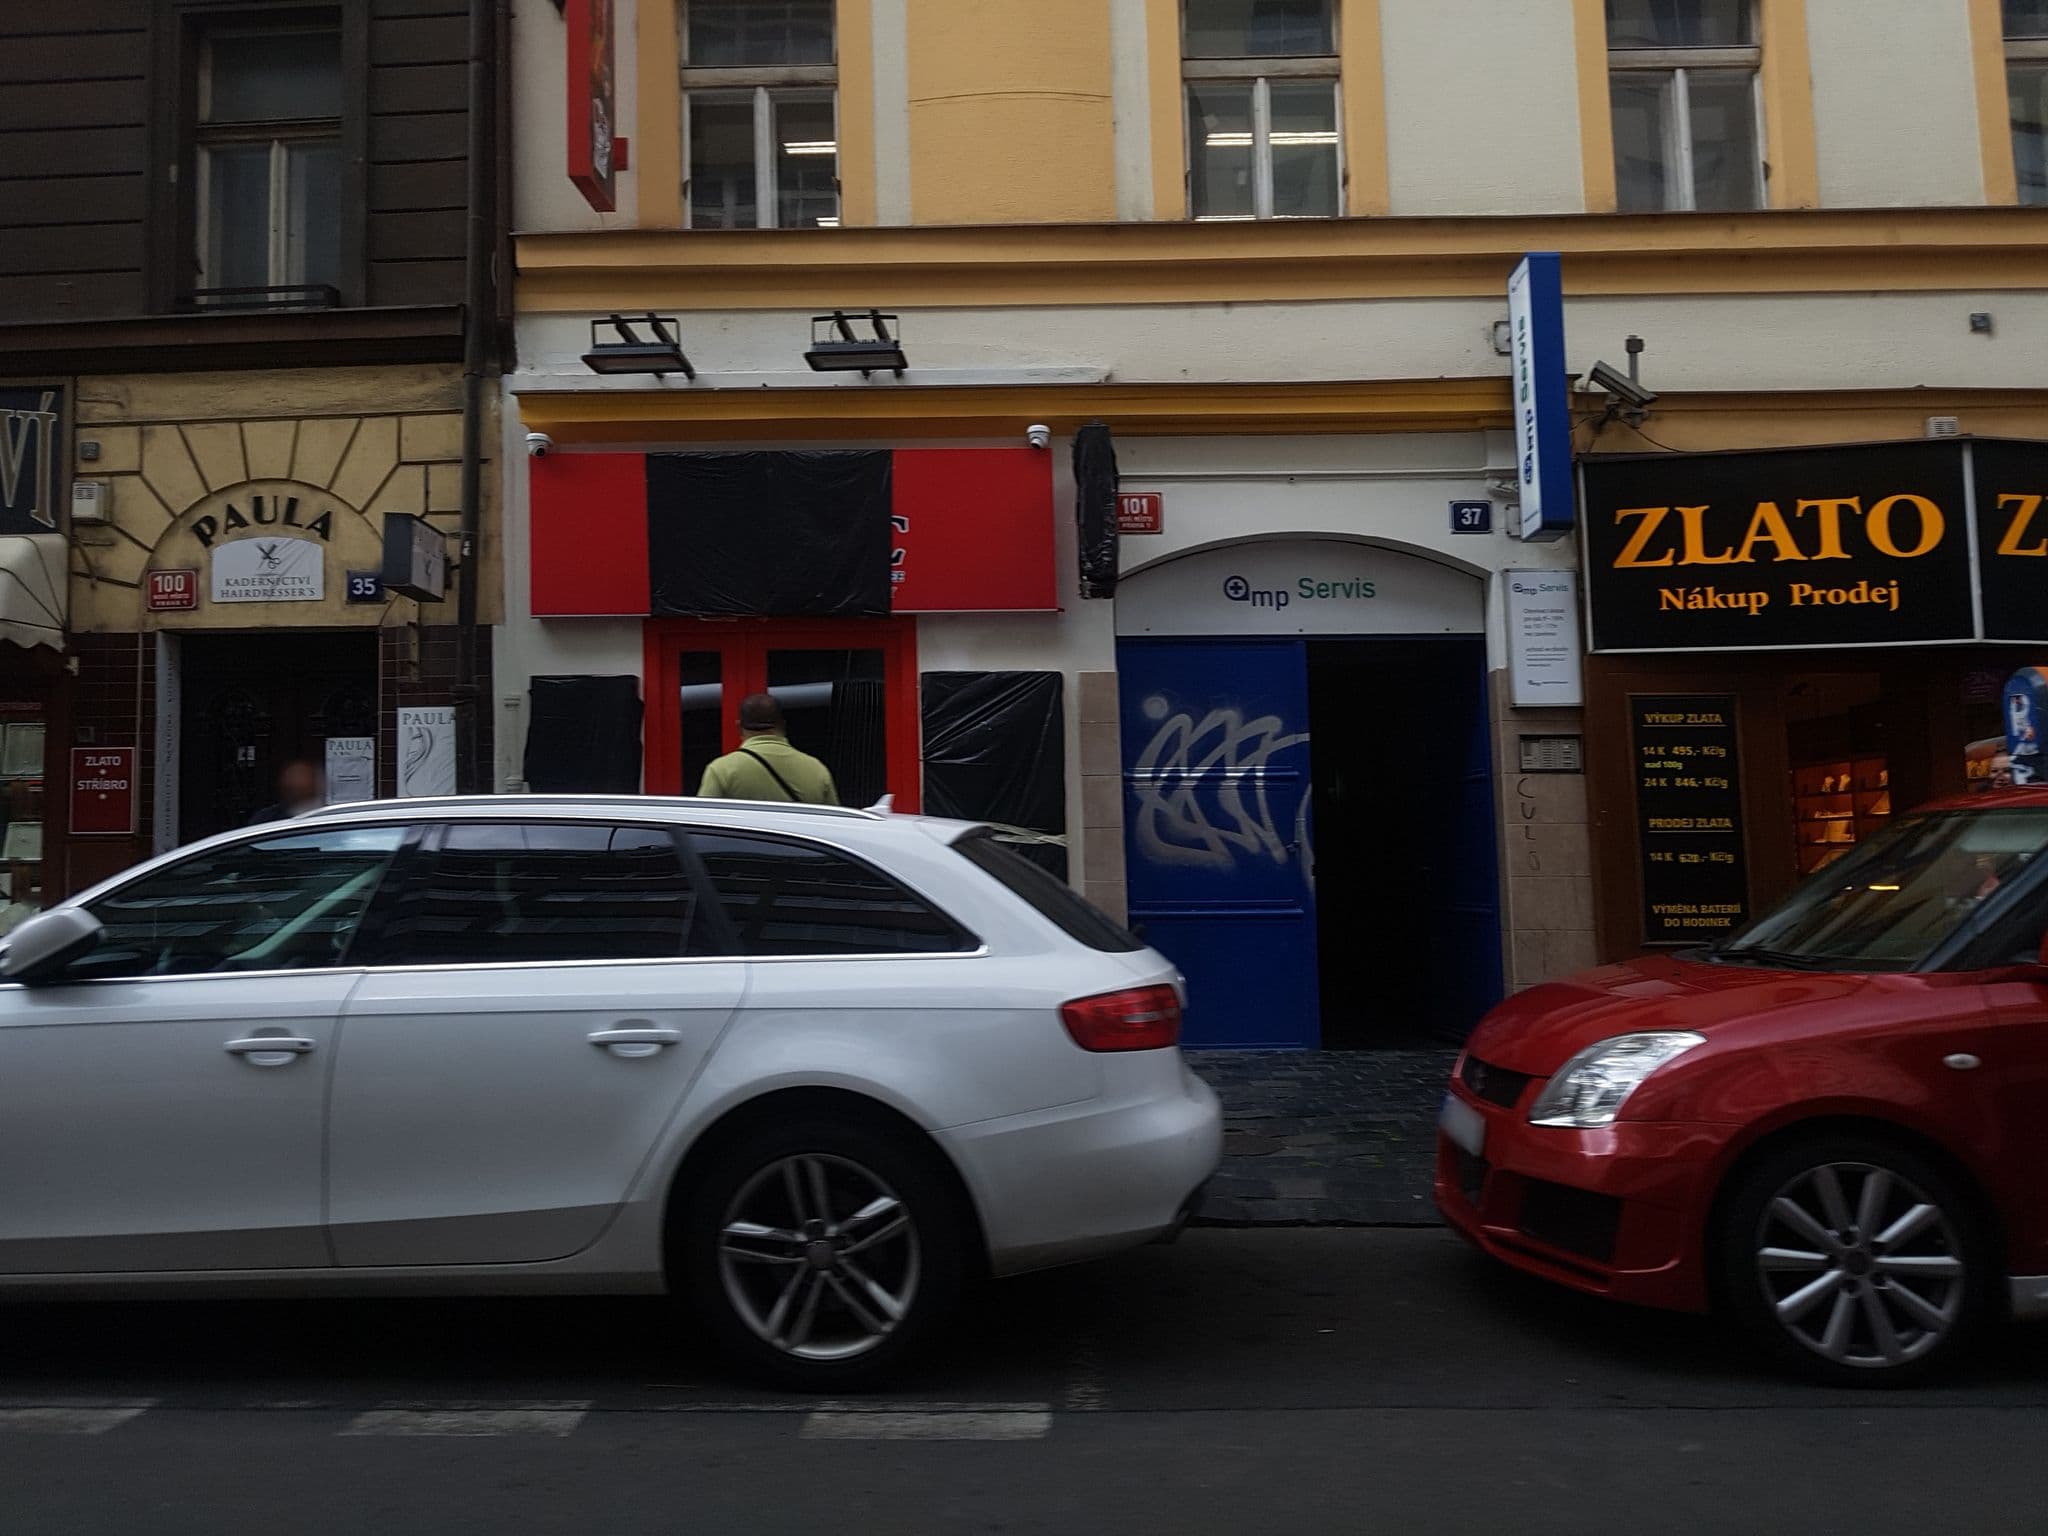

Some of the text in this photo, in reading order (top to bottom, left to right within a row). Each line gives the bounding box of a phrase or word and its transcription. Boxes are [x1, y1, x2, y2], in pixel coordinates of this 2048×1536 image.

[1518, 316, 1530, 403] Servis
[1122, 497, 1149, 515] 101
[191, 495, 334, 548] PAULA
[1461, 508, 1482, 526] 37
[1613, 493, 2048, 568] ZLATO Z
[153, 575, 185, 593] 100
[352, 577, 377, 595] 35
[1298, 576, 1376, 599] Servis
[1538, 583, 1569, 593] Servis
[1659, 581, 1899, 615] Nákup Prodej
[402, 713, 457, 726] PAULA
[1643, 711, 1724, 724] VÝKUP ZLATA
[328, 740, 373, 751] PAULA
[84, 756, 122, 767] ZLATO
[77, 778, 128, 791] STŘÍBRO
[1648, 817, 1734, 829] PRODEJ ZLATA
[1652, 902, 1698, 914] VÝMĚNA
[1663, 916, 1733, 928] DO HODINEK
